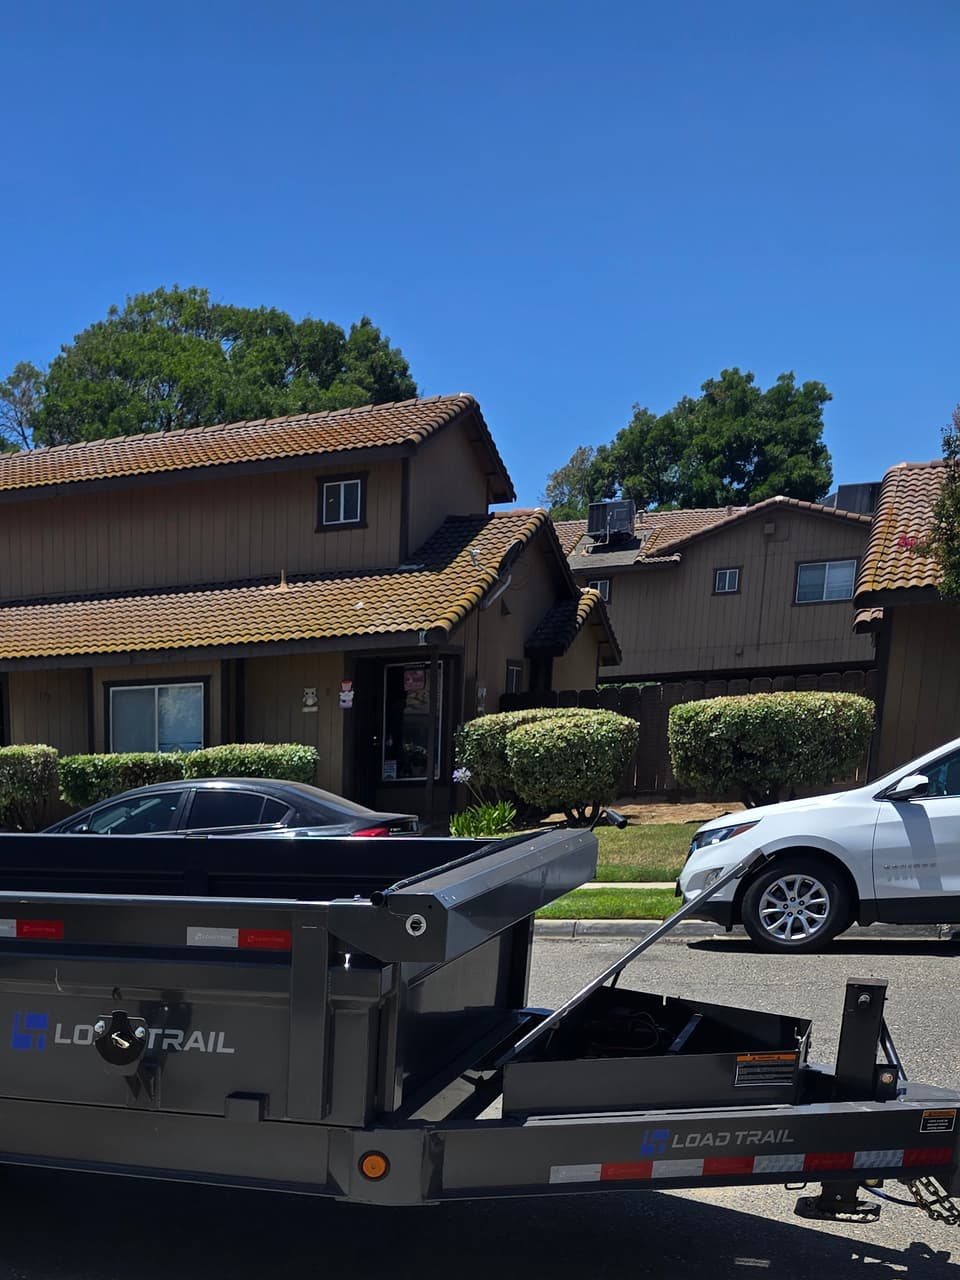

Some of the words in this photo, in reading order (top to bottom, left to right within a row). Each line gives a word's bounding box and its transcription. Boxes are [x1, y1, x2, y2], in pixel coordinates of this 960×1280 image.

[146, 1028, 235, 1054] TRAIL
[672, 1132, 731, 1148] LOAD
[735, 1129, 795, 1145] TRAIL
